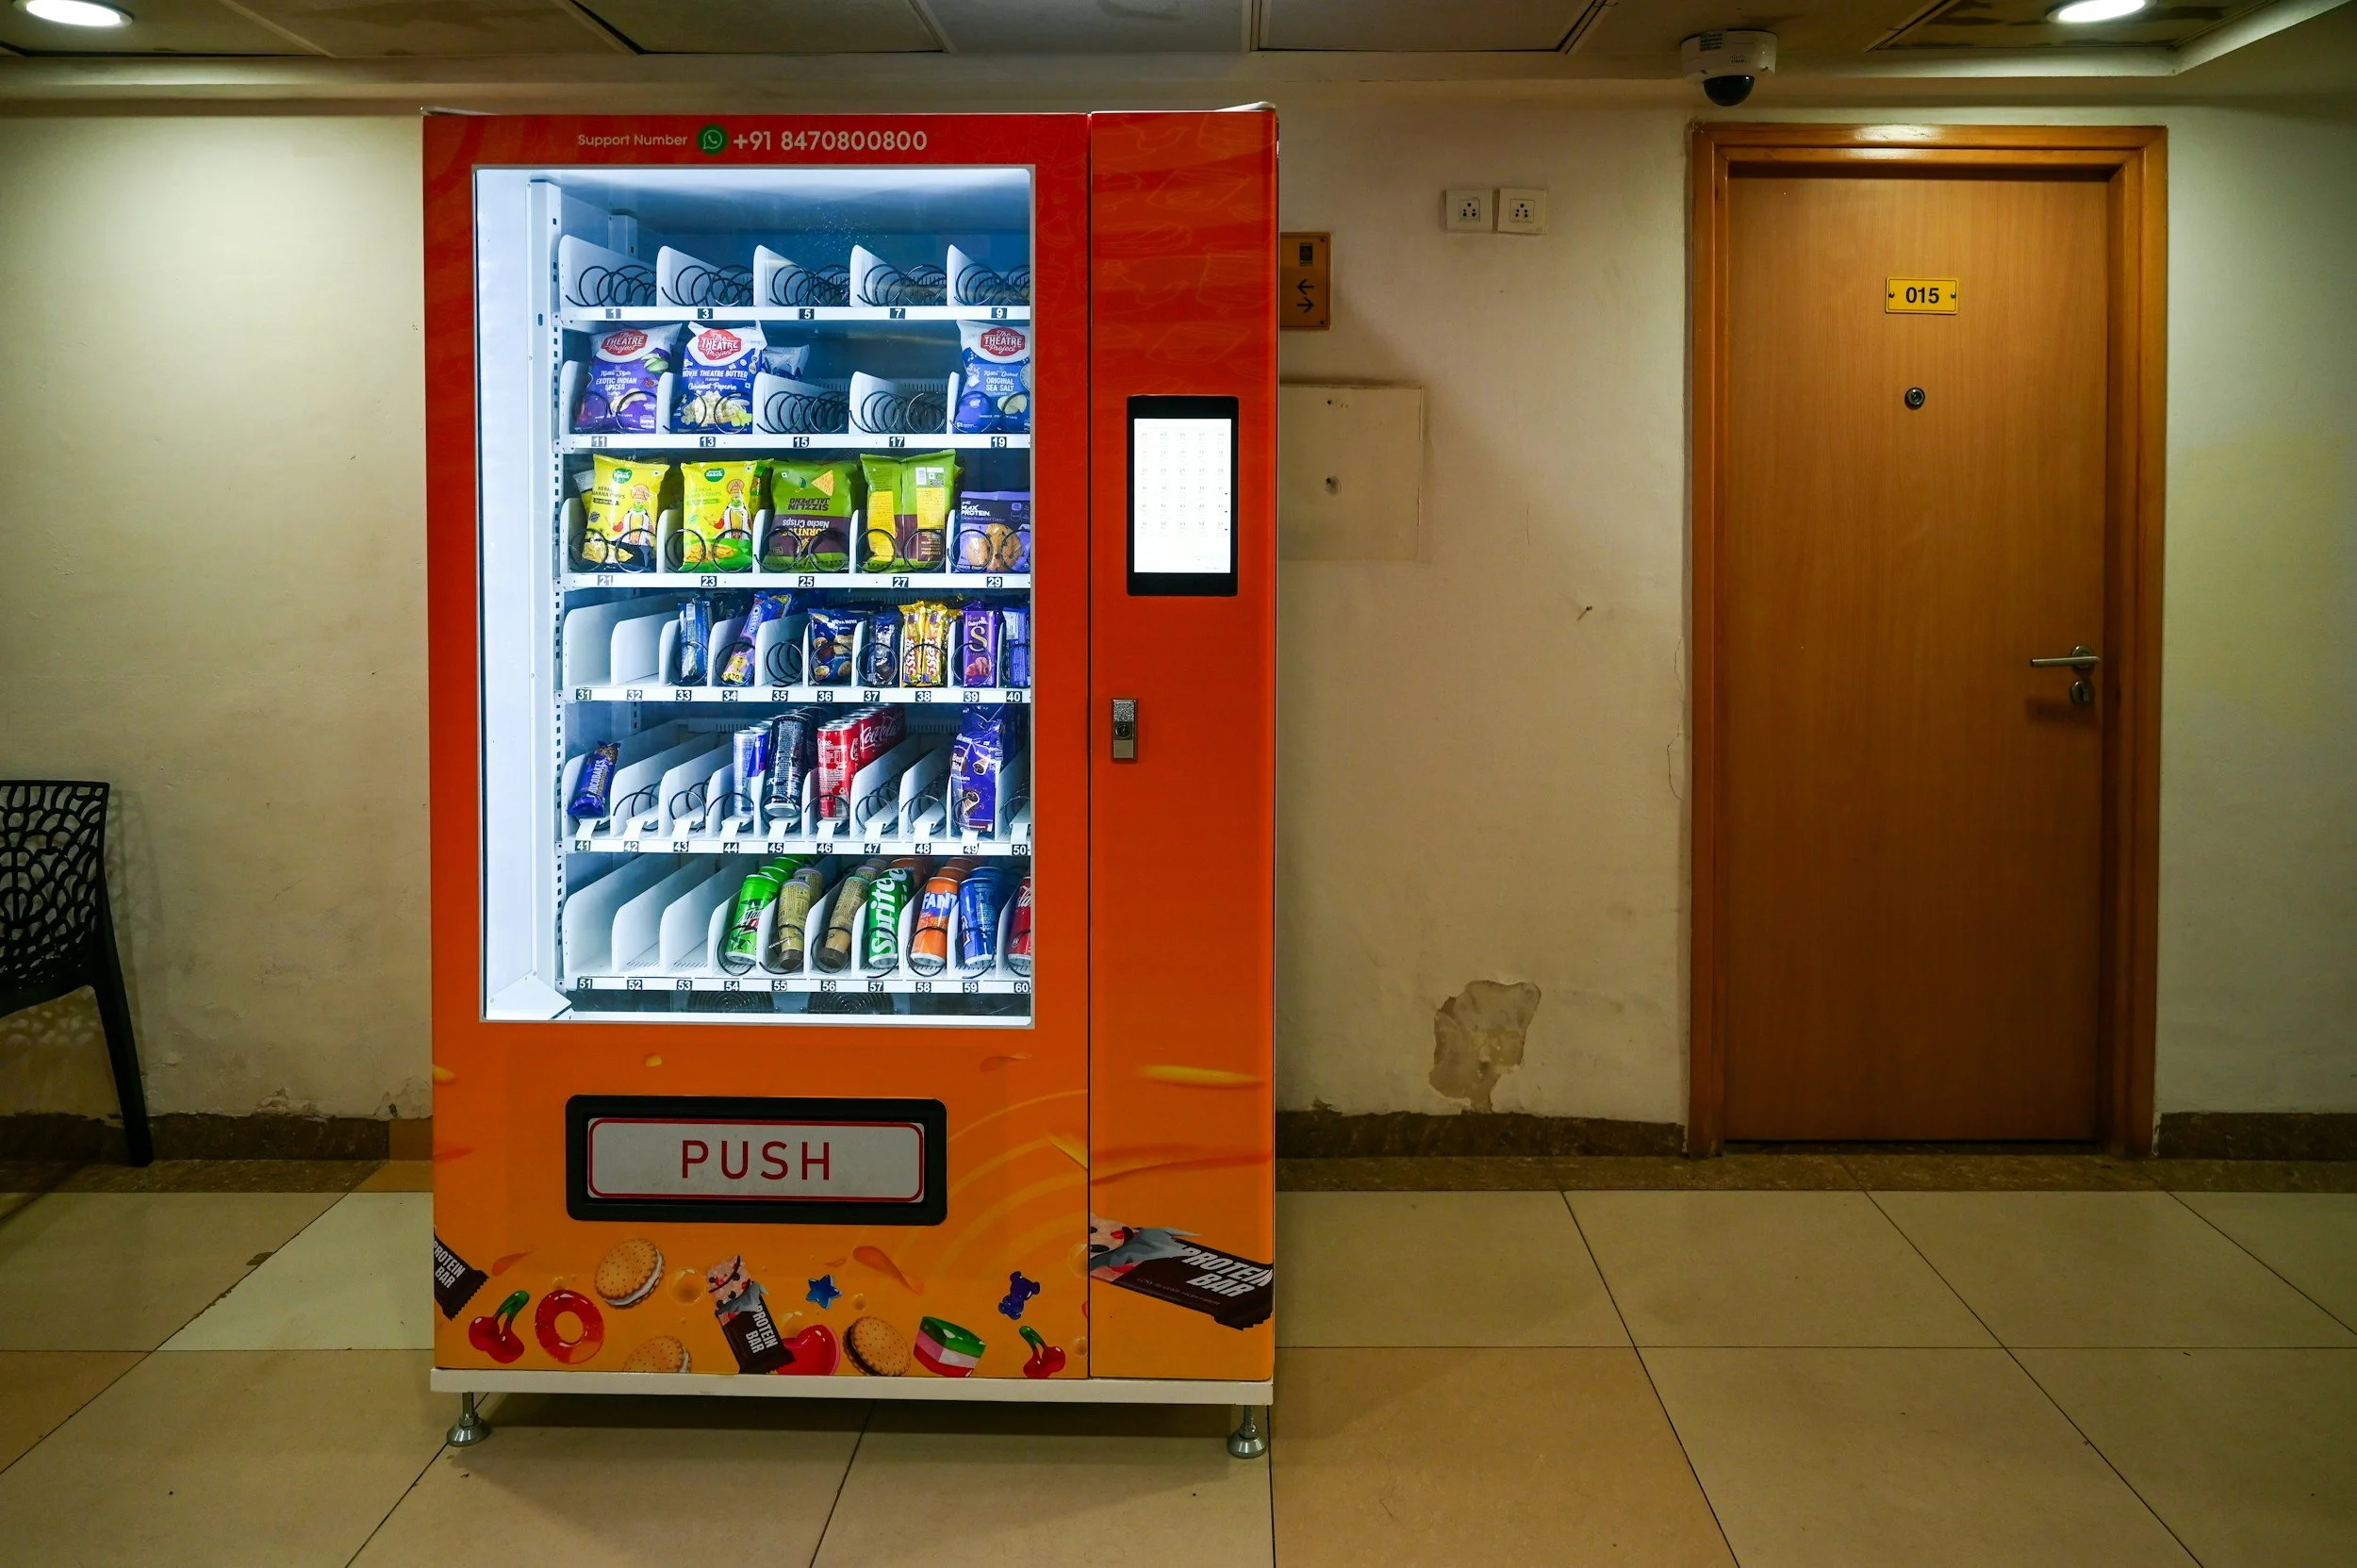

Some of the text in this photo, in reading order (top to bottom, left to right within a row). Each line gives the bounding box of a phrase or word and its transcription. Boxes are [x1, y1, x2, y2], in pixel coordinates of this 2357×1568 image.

[577, 130, 927, 151] Support Number +91 8470800800
[1905, 287, 1939, 304] 015
[611, 309, 617, 319] 1
[702, 308, 710, 319] 3
[804, 308, 812, 319] 5
[894, 308, 902, 319] 7
[996, 308, 1003, 319] 9
[606, 337, 644, 345] THEATRE
[701, 338, 738, 350] THEATRE
[984, 337, 1021, 346] THEATRE
[609, 344, 636, 354] Project
[706, 349, 733, 358] Project
[989, 344, 1016, 354] Project
[726, 371, 749, 379] BUTTER
[594, 437, 605, 447] 11
[702, 437, 715, 447] 13
[795, 437, 808, 447] 15
[891, 437, 903, 447] 17
[993, 437, 1006, 447] 19
[783, 519, 806, 527] Crisps
[599, 576, 612, 586] 21
[702, 576, 716, 586] 23
[799, 577, 814, 587] 25
[894, 578, 908, 587] 27
[987, 578, 1001, 587] 29
[748, 604, 762, 634] OREO
[577, 689, 591, 700] 31
[628, 690, 642, 701] 32
[677, 690, 691, 701] 33
[723, 691, 737, 701] 34
[773, 691, 787, 701] 35
[817, 691, 832, 701] 36
[865, 691, 879, 701] 37
[916, 691, 931, 701] 38
[964, 691, 979, 701] 39
[1006, 691, 1021, 701] 40
[577, 841, 589, 850] 41
[624, 841, 638, 851] 42
[674, 842, 688, 851] 43
[724, 843, 738, 853] 44
[768, 843, 783, 853] 45
[817, 843, 832, 853] 46
[865, 844, 878, 853] 47
[915, 844, 931, 853] 48
[964, 844, 978, 853] 49
[1014, 845, 1027, 854] 50
[870, 878, 897, 954] Sprite
[579, 979, 592, 989] 51
[628, 980, 642, 990] 52
[678, 981, 692, 990] 53
[725, 982, 739, 991] 54
[773, 981, 787, 990] 55
[822, 982, 836, 991] 56
[869, 982, 882, 991] 57
[916, 982, 931, 992] 58
[964, 982, 978, 992] 59
[1015, 982, 1029, 992] 60
[682, 1140, 830, 1180] PUSH
[435, 1239, 466, 1279] PROTEIN
[1180, 1243, 1273, 1287] PROTEIN
[435, 1266, 456, 1288] BAR
[1185, 1273, 1256, 1297] BAR
[751, 1302, 779, 1348] PROTEIN
[745, 1329, 765, 1354] BAR
